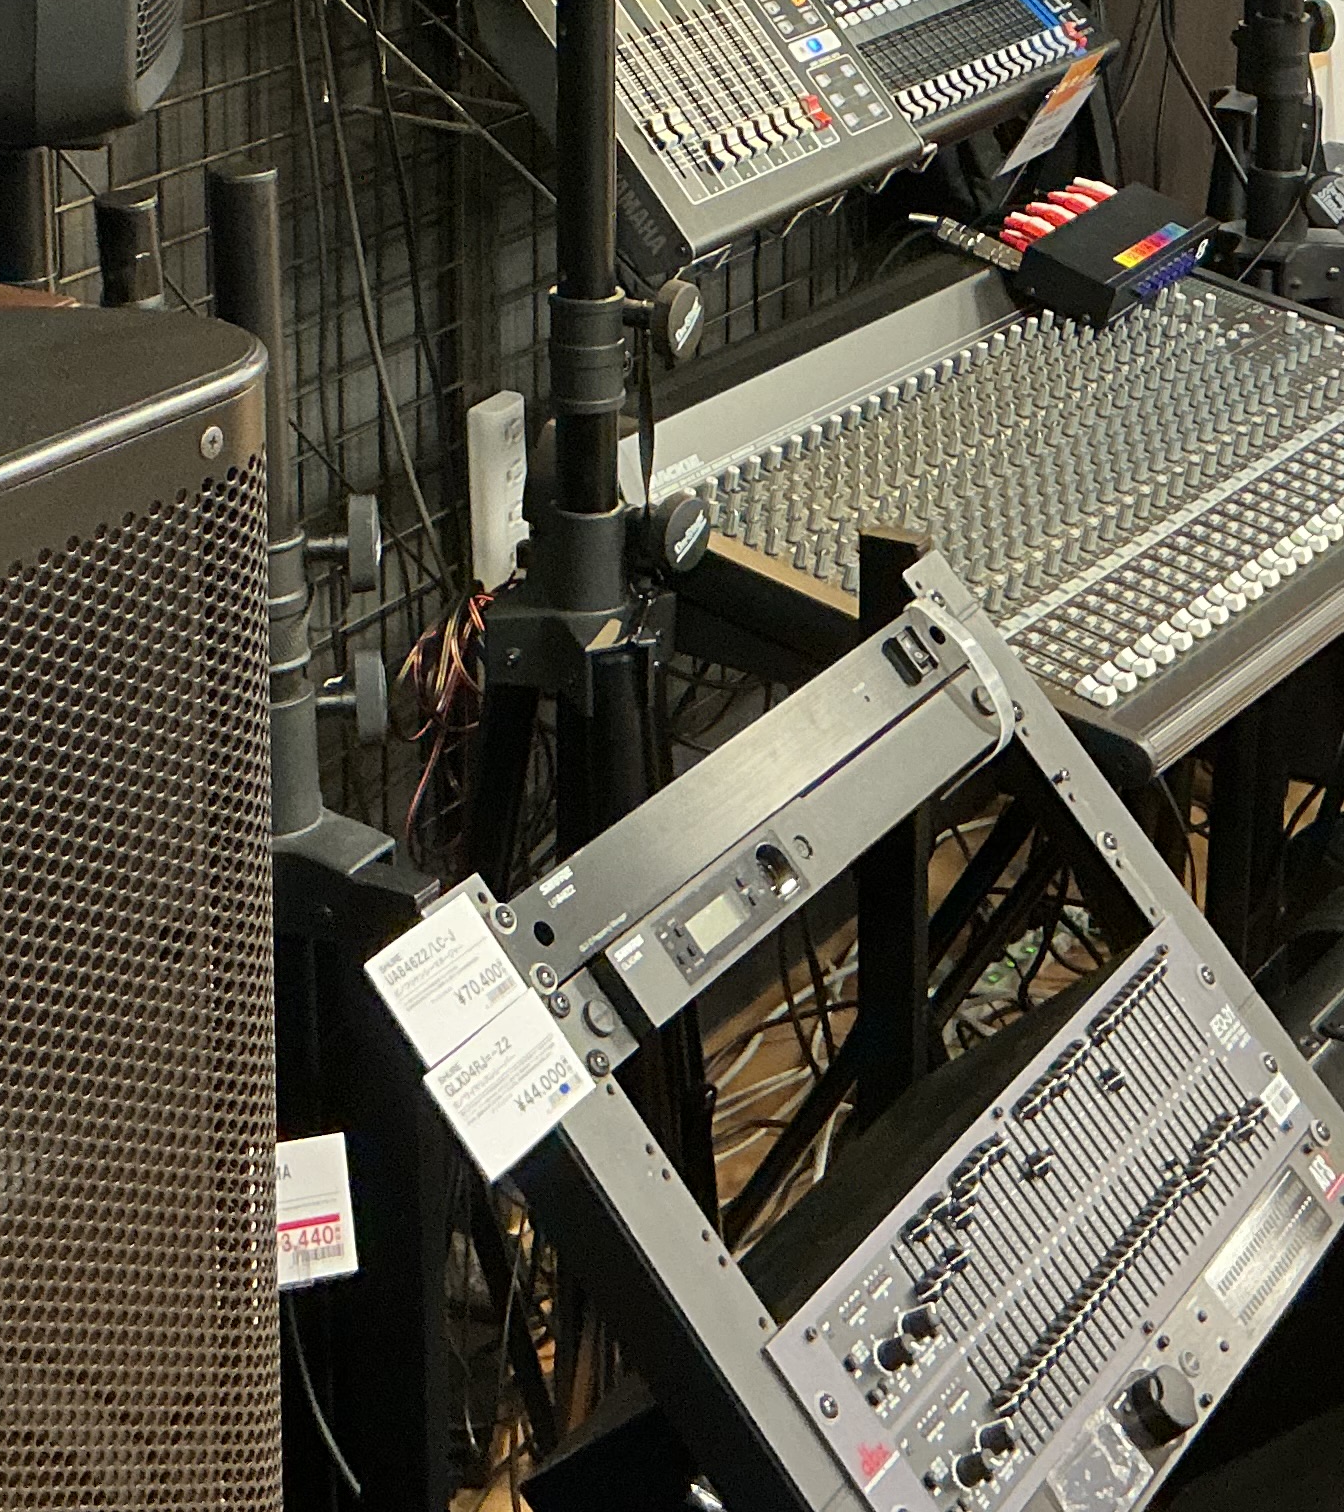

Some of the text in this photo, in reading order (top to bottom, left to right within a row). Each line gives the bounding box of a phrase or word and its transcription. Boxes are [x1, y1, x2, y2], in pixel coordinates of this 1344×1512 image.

[616, 172, 668, 258] AMAHA
[454, 963, 502, 1006] ¥70,400
[513, 1062, 568, 1113] ¥44,000
